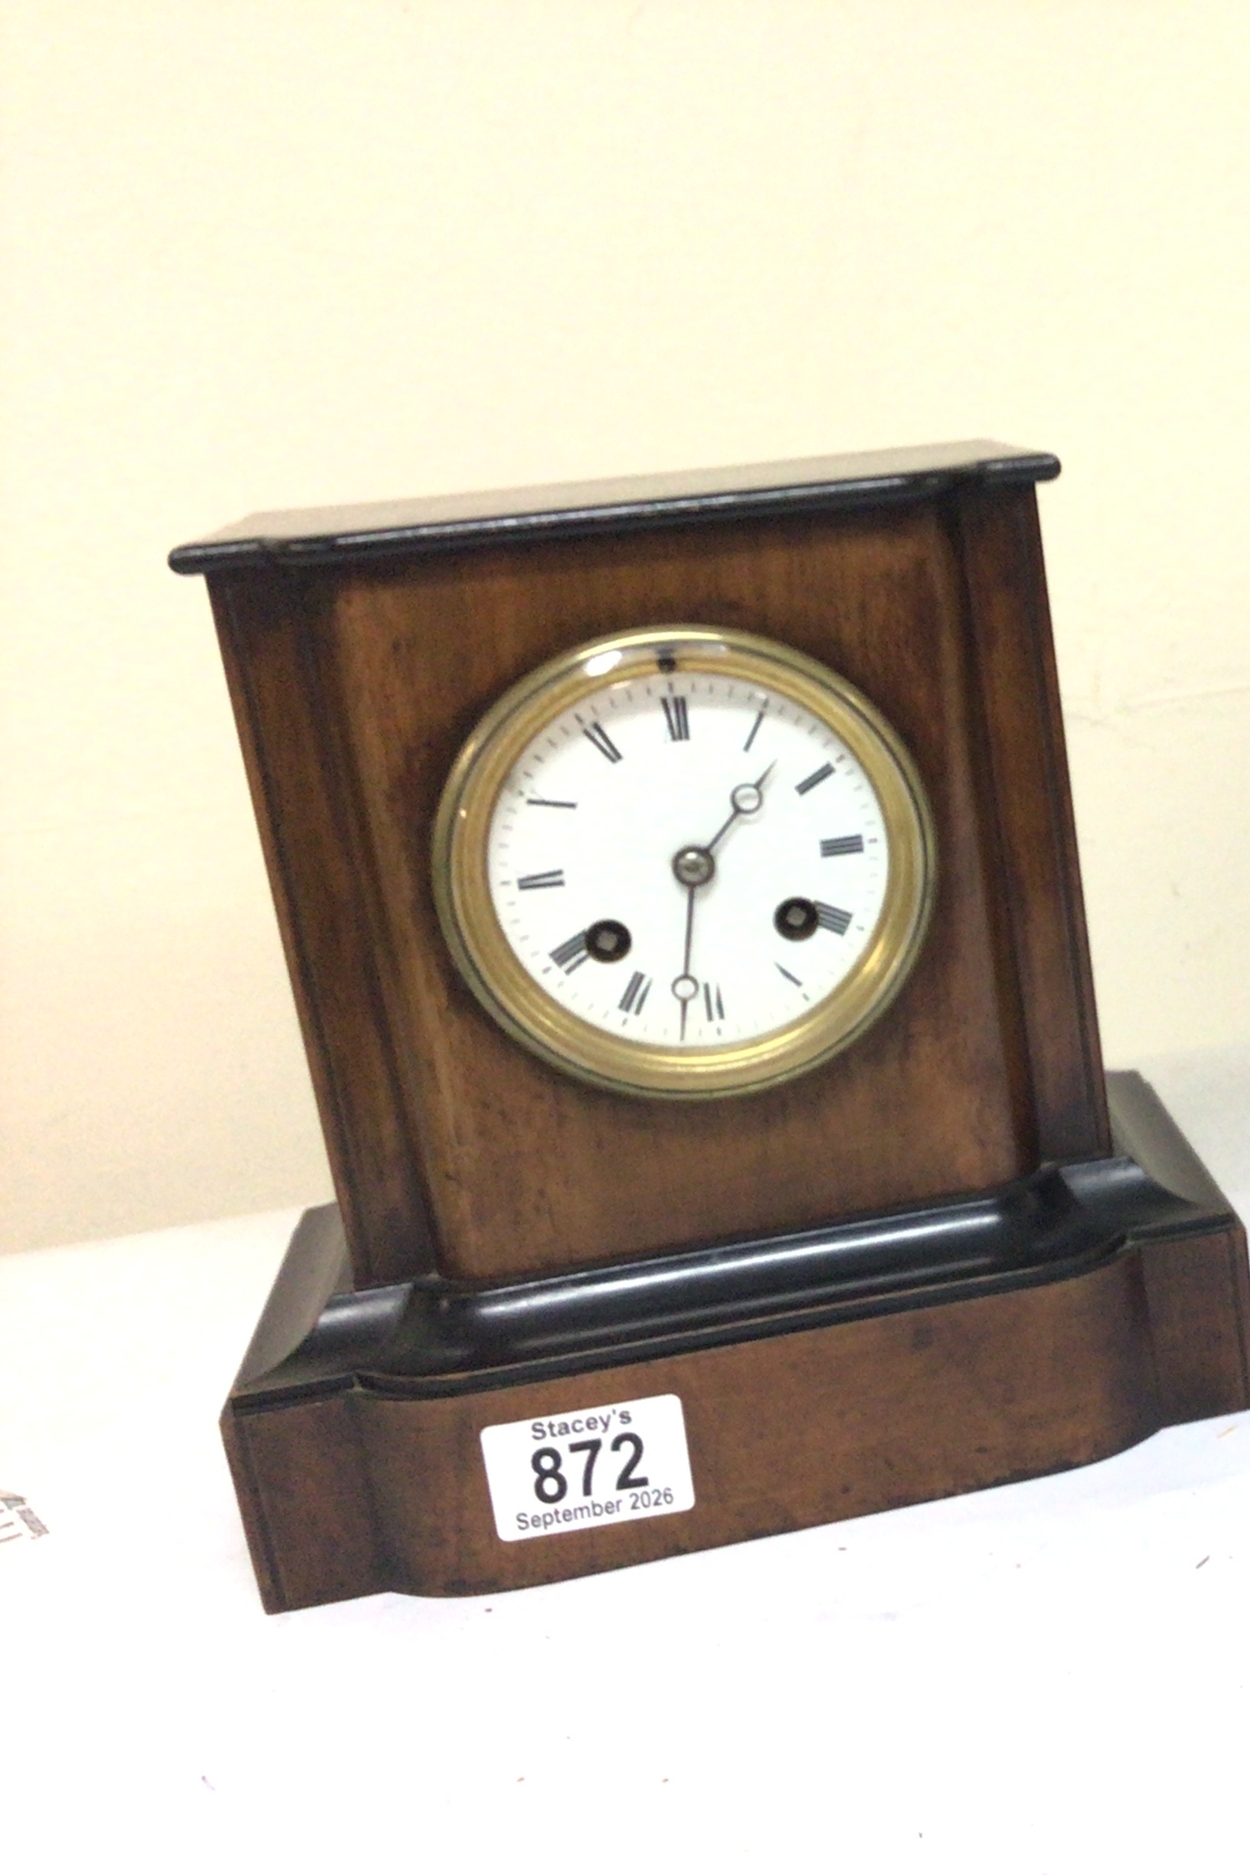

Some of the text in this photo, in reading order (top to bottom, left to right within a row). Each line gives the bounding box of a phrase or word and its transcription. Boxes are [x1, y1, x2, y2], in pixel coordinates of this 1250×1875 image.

[531, 1409, 632, 1441] Stacey's
[530, 1432, 649, 1504] 872
[516, 1487, 674, 1531] September 2026
